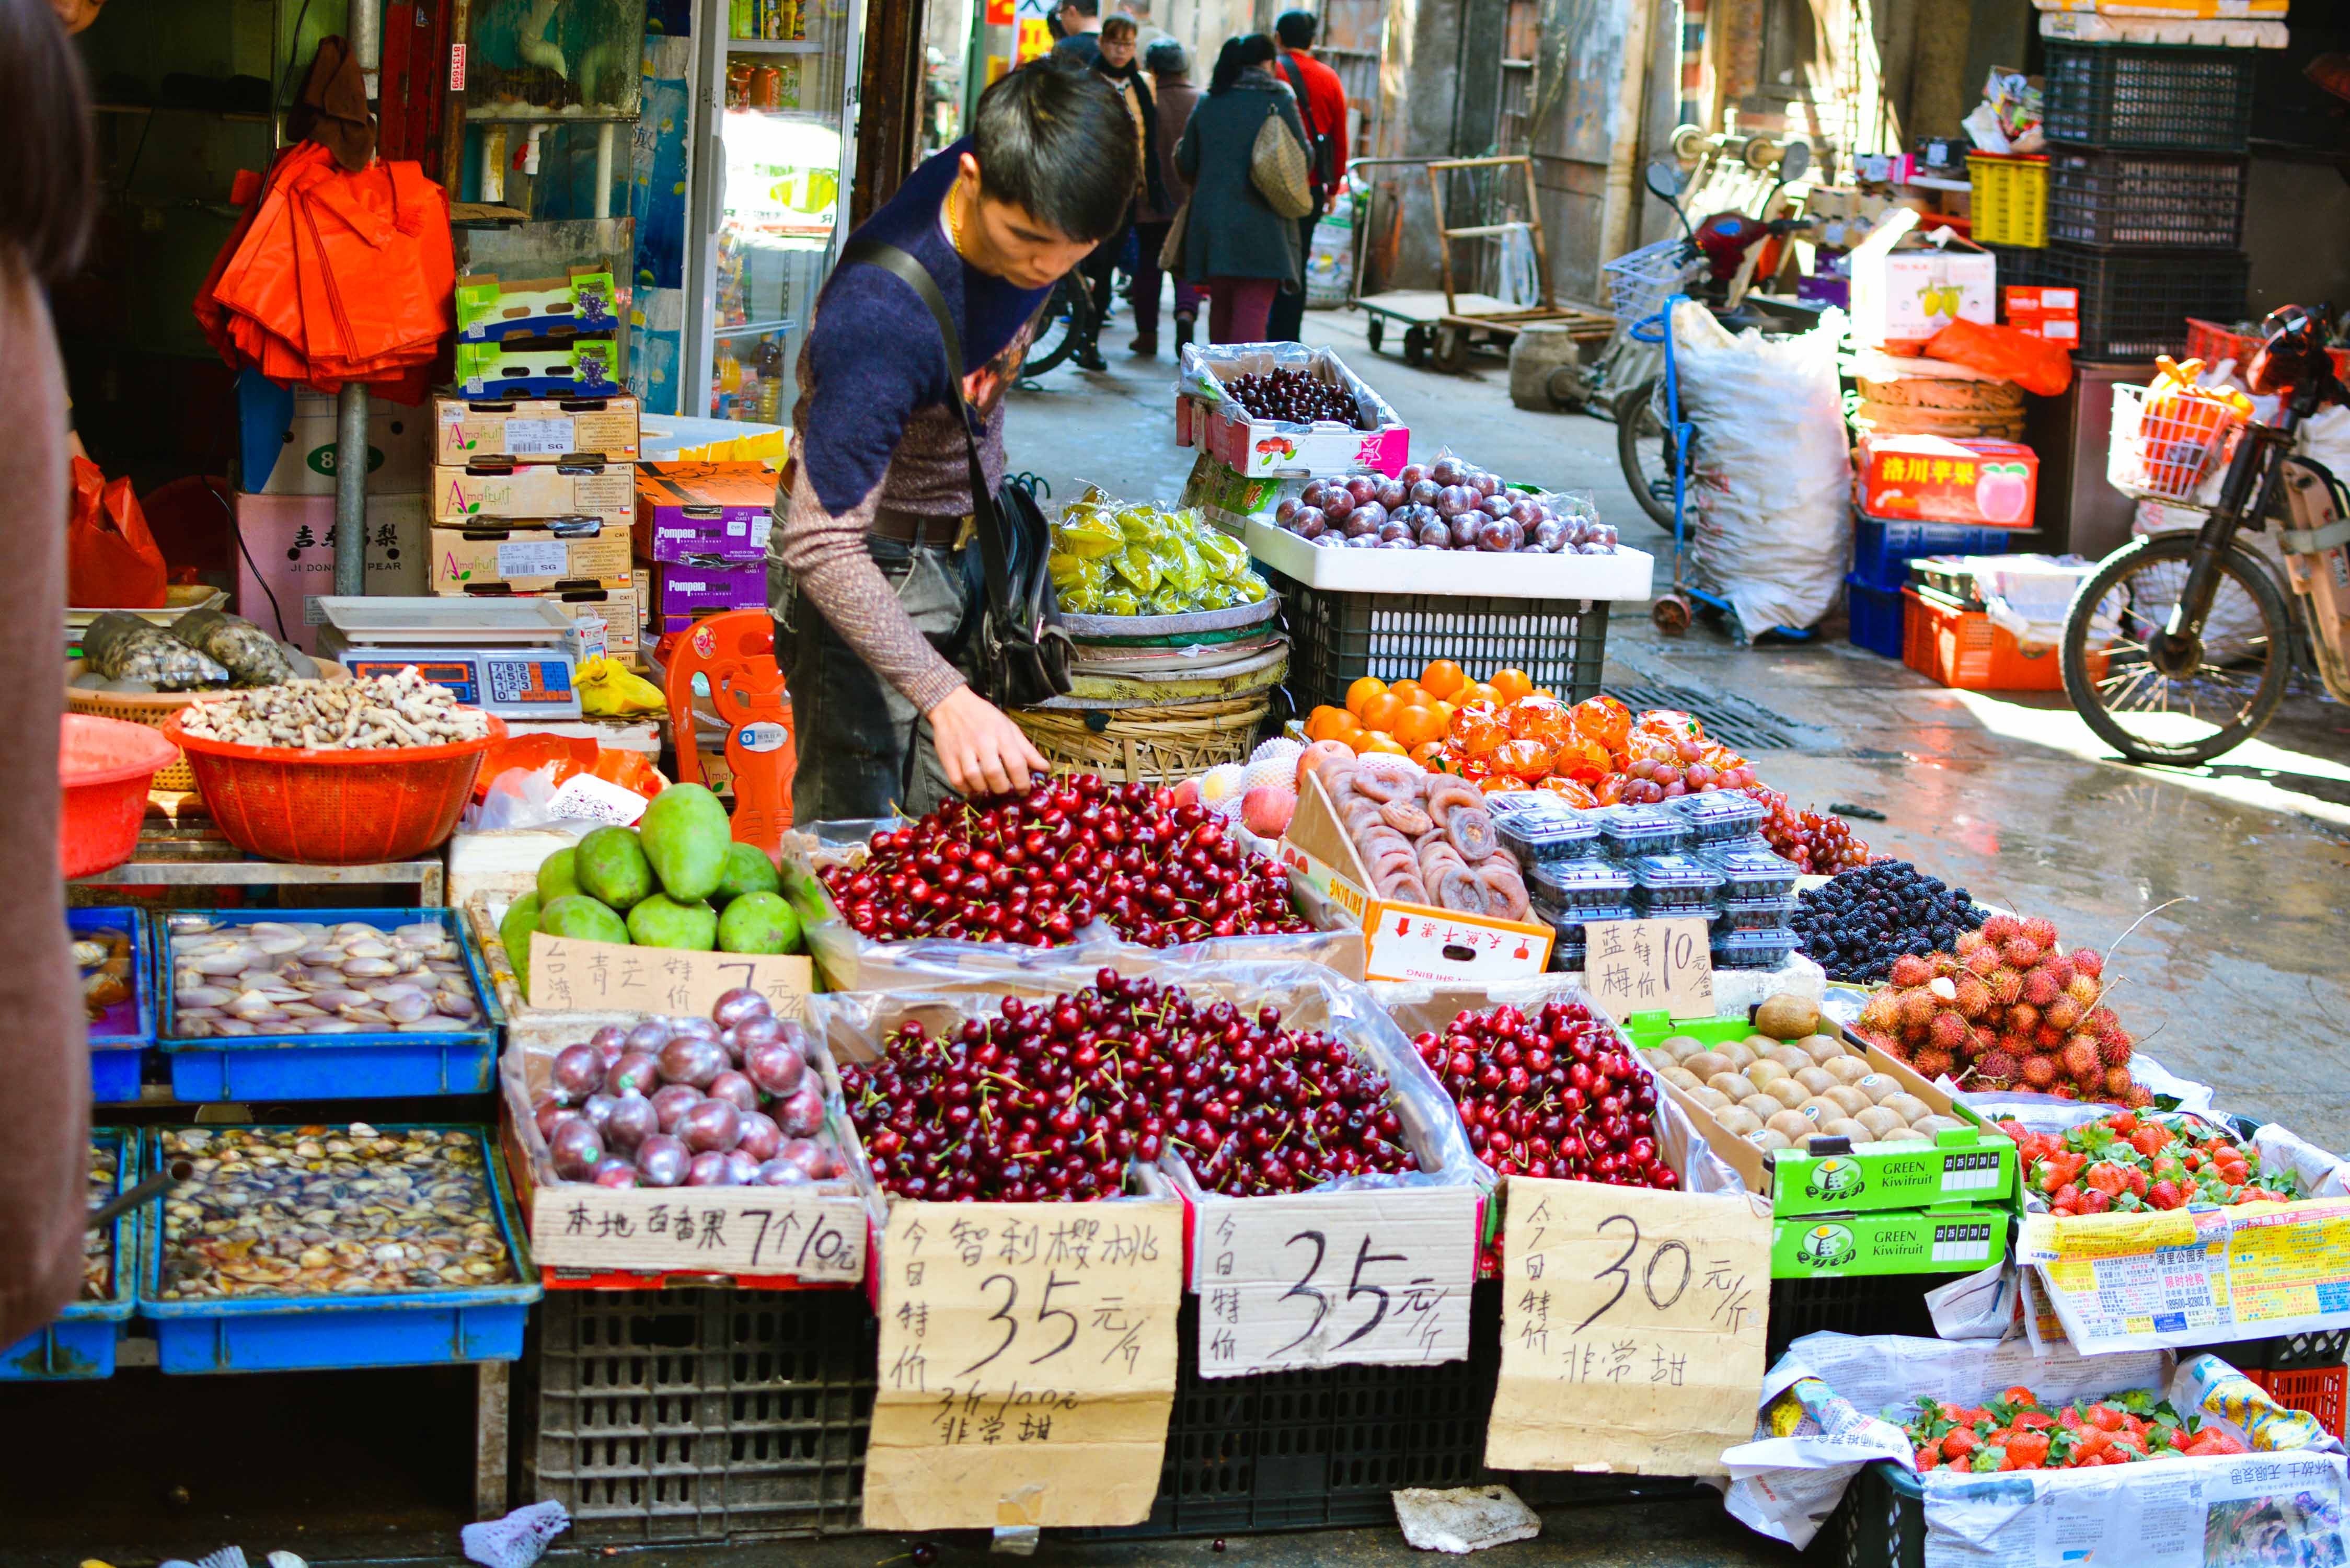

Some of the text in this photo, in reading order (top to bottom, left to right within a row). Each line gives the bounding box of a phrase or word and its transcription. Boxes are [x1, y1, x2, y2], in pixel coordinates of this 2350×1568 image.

[446, 479, 511, 515] Almafruit
[294, 523, 398, 548] 吉东梨
[368, 562, 401, 571] PEAR
[1329, 878, 1364, 917] SHI BING
[1420, 922, 1503, 949] 天然干果
[1406, 969, 1433, 979] BING
[1883, 1161, 1926, 1175] GREEN
[1945, 1155, 1998, 1168] 22 25 27 30 33
[1882, 1174, 1932, 1187] Kiwifruit
[1874, 1230, 1917, 1243] GREEN
[1937, 1227, 1989, 1238] 22 25 27 30 33
[949, 1217, 1160, 1270] 智利樱桃
[1873, 1244, 1924, 1256] Kiwifruit
[2156, 1249, 2206, 1266] 湖里公园旁
[2164, 1272, 2205, 1288] 限时抢购
[1560, 1339, 1688, 1387] 非常甜
[941, 1414, 1053, 1445] 非常甜
[2229, 1463, 2281, 1485] 无限哀思
